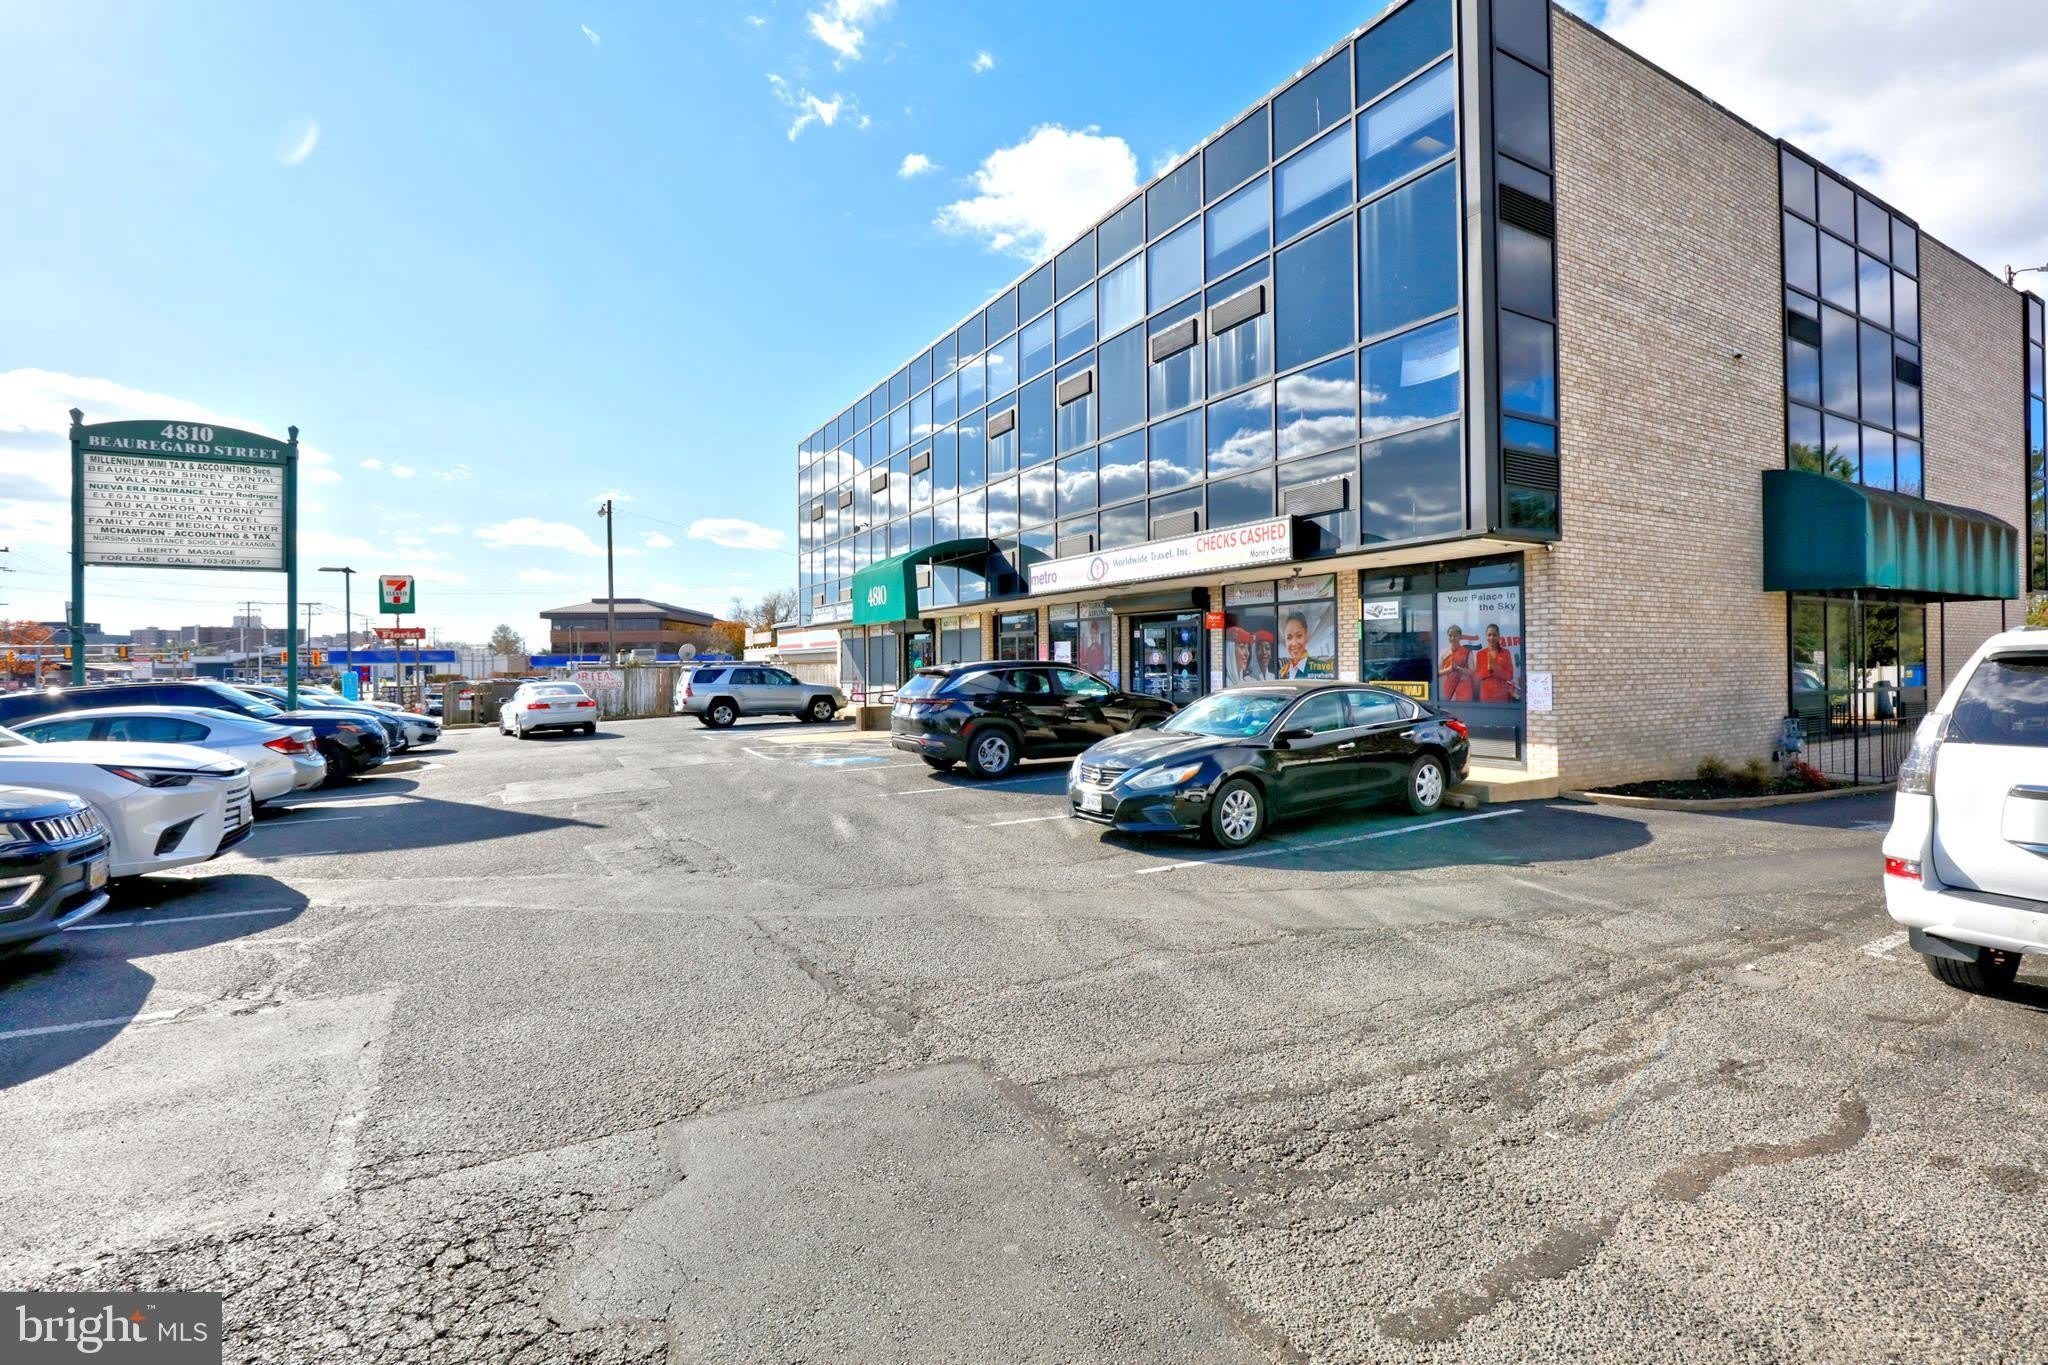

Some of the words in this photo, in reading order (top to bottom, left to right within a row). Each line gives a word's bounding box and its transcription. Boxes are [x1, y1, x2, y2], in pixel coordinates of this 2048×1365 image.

[161, 424, 214, 442] 4810
[88, 435, 210, 454] BEAUREGARD
[214, 445, 280, 459] STREET
[90, 455, 145, 467] MILLENNIUM
[148, 460, 167, 468] MIMI
[170, 461, 186, 470] TAX
[197, 463, 251, 474] ACCOUNTING
[253, 467, 271, 475] Svcs
[87, 465, 175, 477] BEAUREGARD
[181, 471, 224, 480] SHINEY
[232, 475, 276, 484] DENTAL
[114, 475, 166, 485] WALK-IN
[227, 482, 259, 491] CARE
[88, 483, 123, 491] NUEVA
[149, 486, 208, 496] INSURANCE,
[210, 490, 234, 499] Larry
[236, 492, 278, 501] Rodriguez
[92, 491, 147, 500] ELEGANT
[153, 495, 194, 504] SMILES
[200, 498, 241, 506] DENTAL
[110, 509, 146, 518] FIRST
[148, 512, 212, 521] AMERICAN
[217, 515, 260, 524] TRAVEL
[135, 503, 199, 513] KALOKOH,
[202, 506, 263, 515] ATTORNEY
[88, 517, 133, 526] FAMILY
[138, 520, 172, 528] CARE
[175, 521, 229, 530] MEDICAL
[232, 524, 278, 533] CENTER
[100, 526, 165, 536] MCHAMPION
[174, 530, 240, 539] ACCOUNTING
[93, 535, 129, 543] NURSING
[1196, 531, 1237, 553] CHECKS
[1239, 523, 1287, 545] CASHED
[187, 548, 236, 556] MASSAGE
[1112, 553, 1149, 568] Worldwide
[1176, 547, 1192, 557] Inc.
[1250, 549, 1269, 558] Money
[1030, 570, 1057, 586] metro
[867, 584, 887, 607] 4810
[1447, 595, 1468, 603] Your
[1471, 593, 1503, 601] Palace
[1479, 603, 1494, 611] the
[1498, 602, 1516, 611] Sky
[382, 631, 420, 639] Florist
[1309, 660, 1334, 671] Travel
